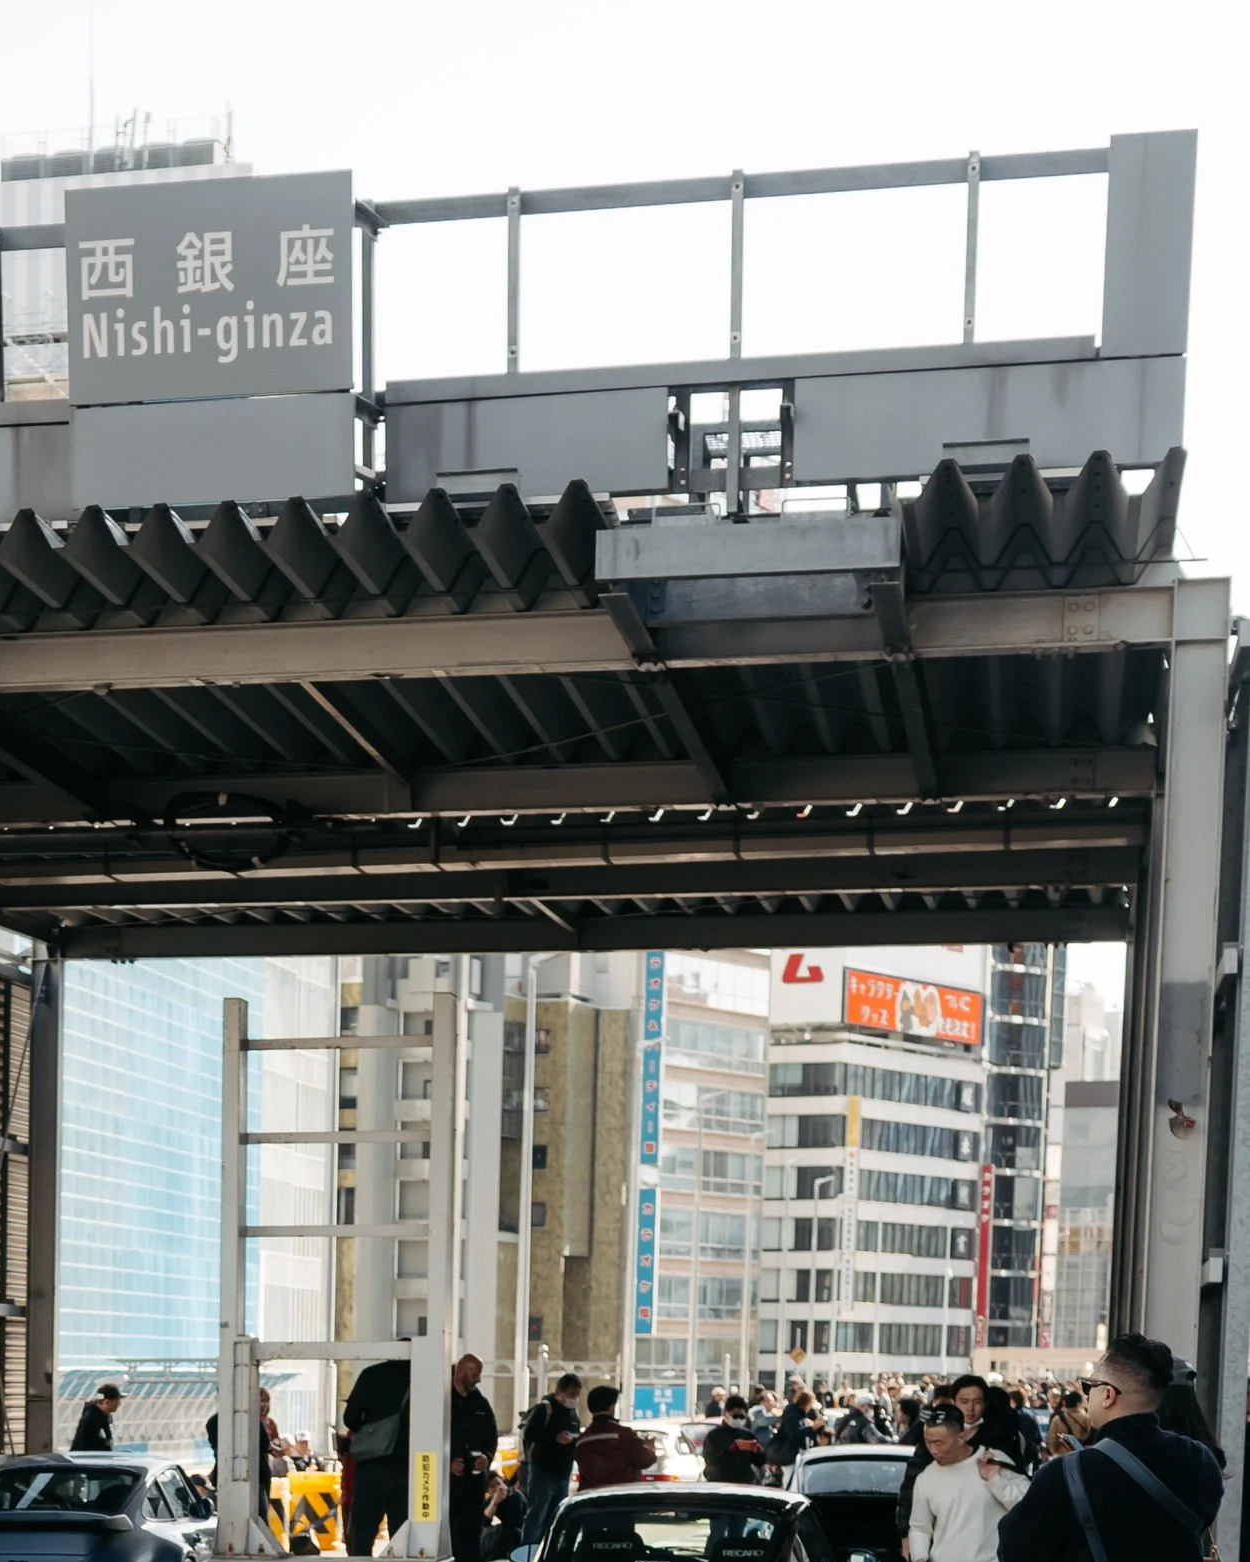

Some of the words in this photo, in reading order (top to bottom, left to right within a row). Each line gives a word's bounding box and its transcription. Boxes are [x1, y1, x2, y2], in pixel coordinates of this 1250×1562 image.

[78, 224, 335, 300] 西銀座
[82, 300, 333, 363] Nishi-ginza
[592, 1541, 633, 1549] RECARO
[722, 1549, 764, 1557] RECARO
